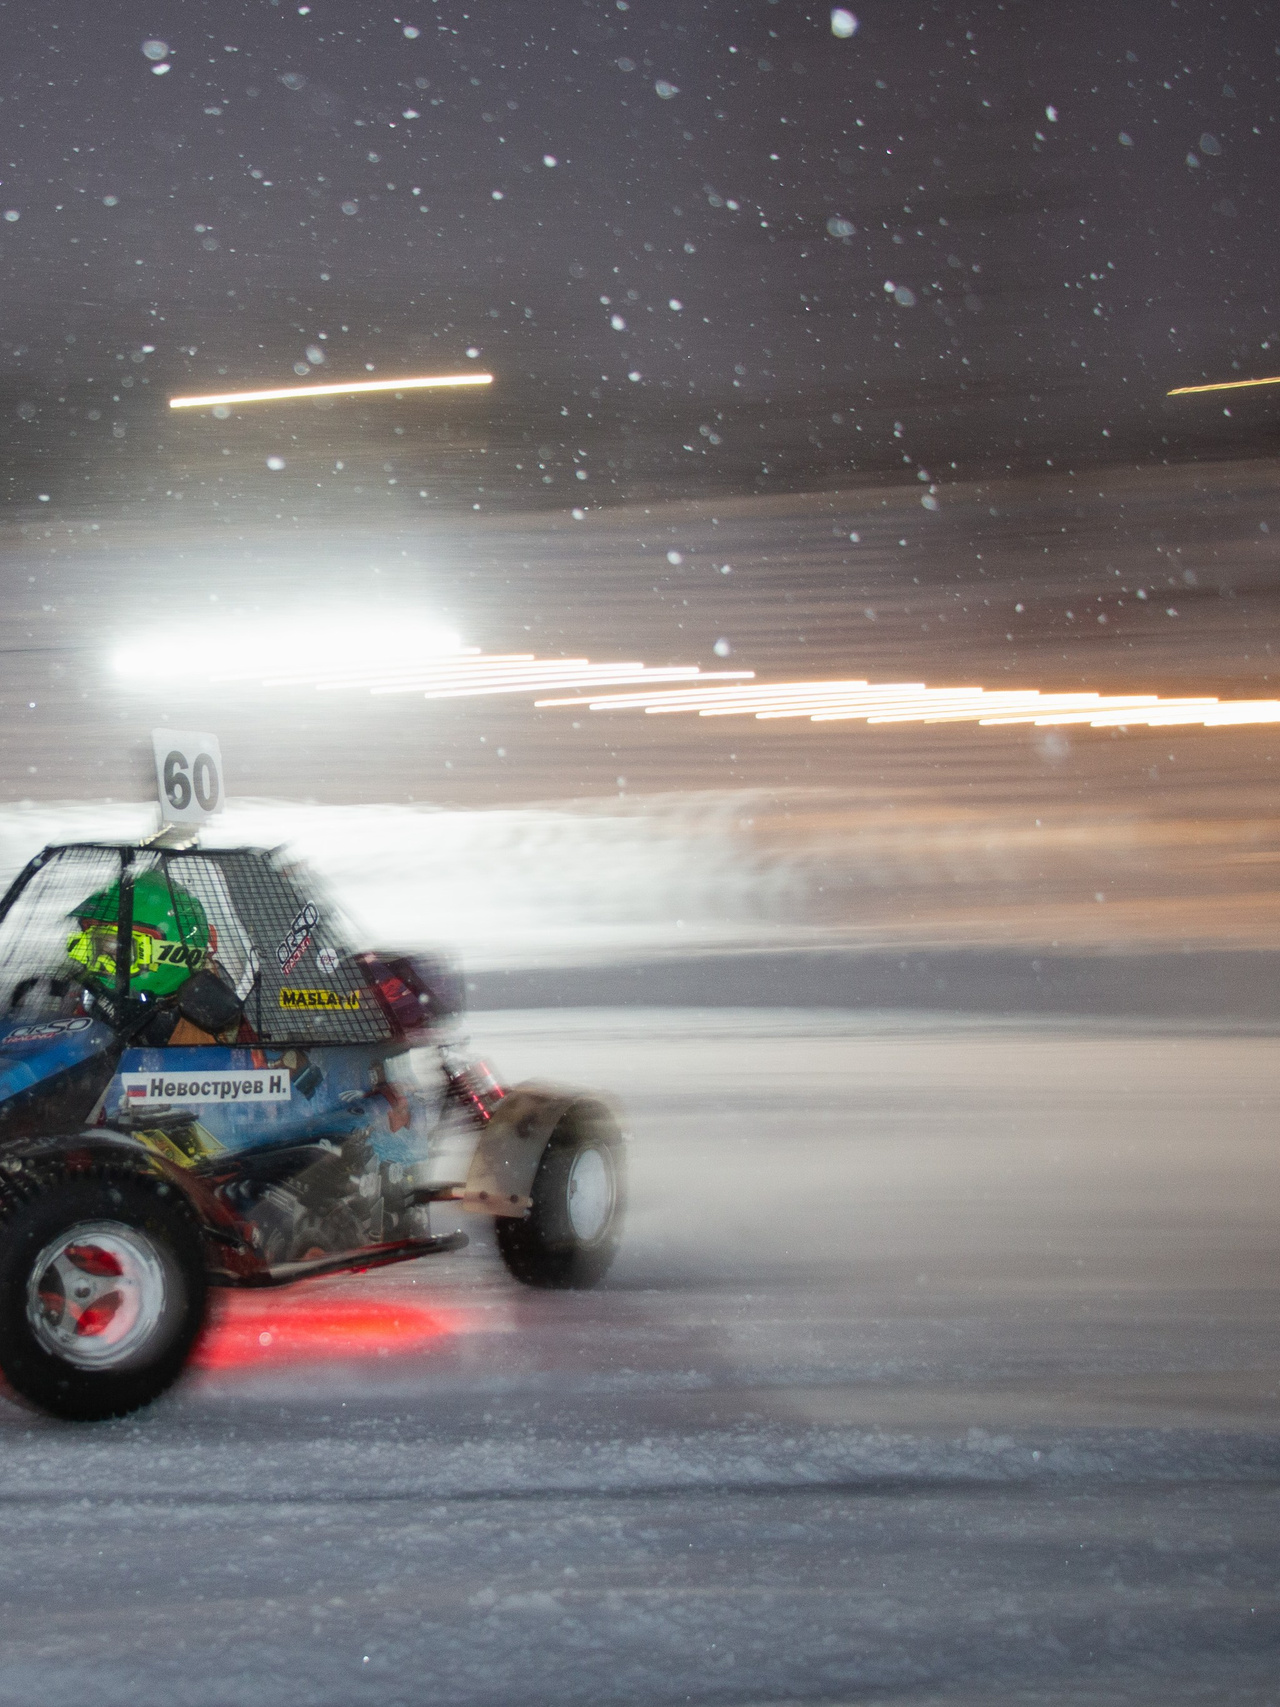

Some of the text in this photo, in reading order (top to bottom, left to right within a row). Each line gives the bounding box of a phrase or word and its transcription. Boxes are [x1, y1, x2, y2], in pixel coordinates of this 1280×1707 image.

[164, 750, 220, 812] 60
[150, 1075, 287, 1099] Невоструев Н.
